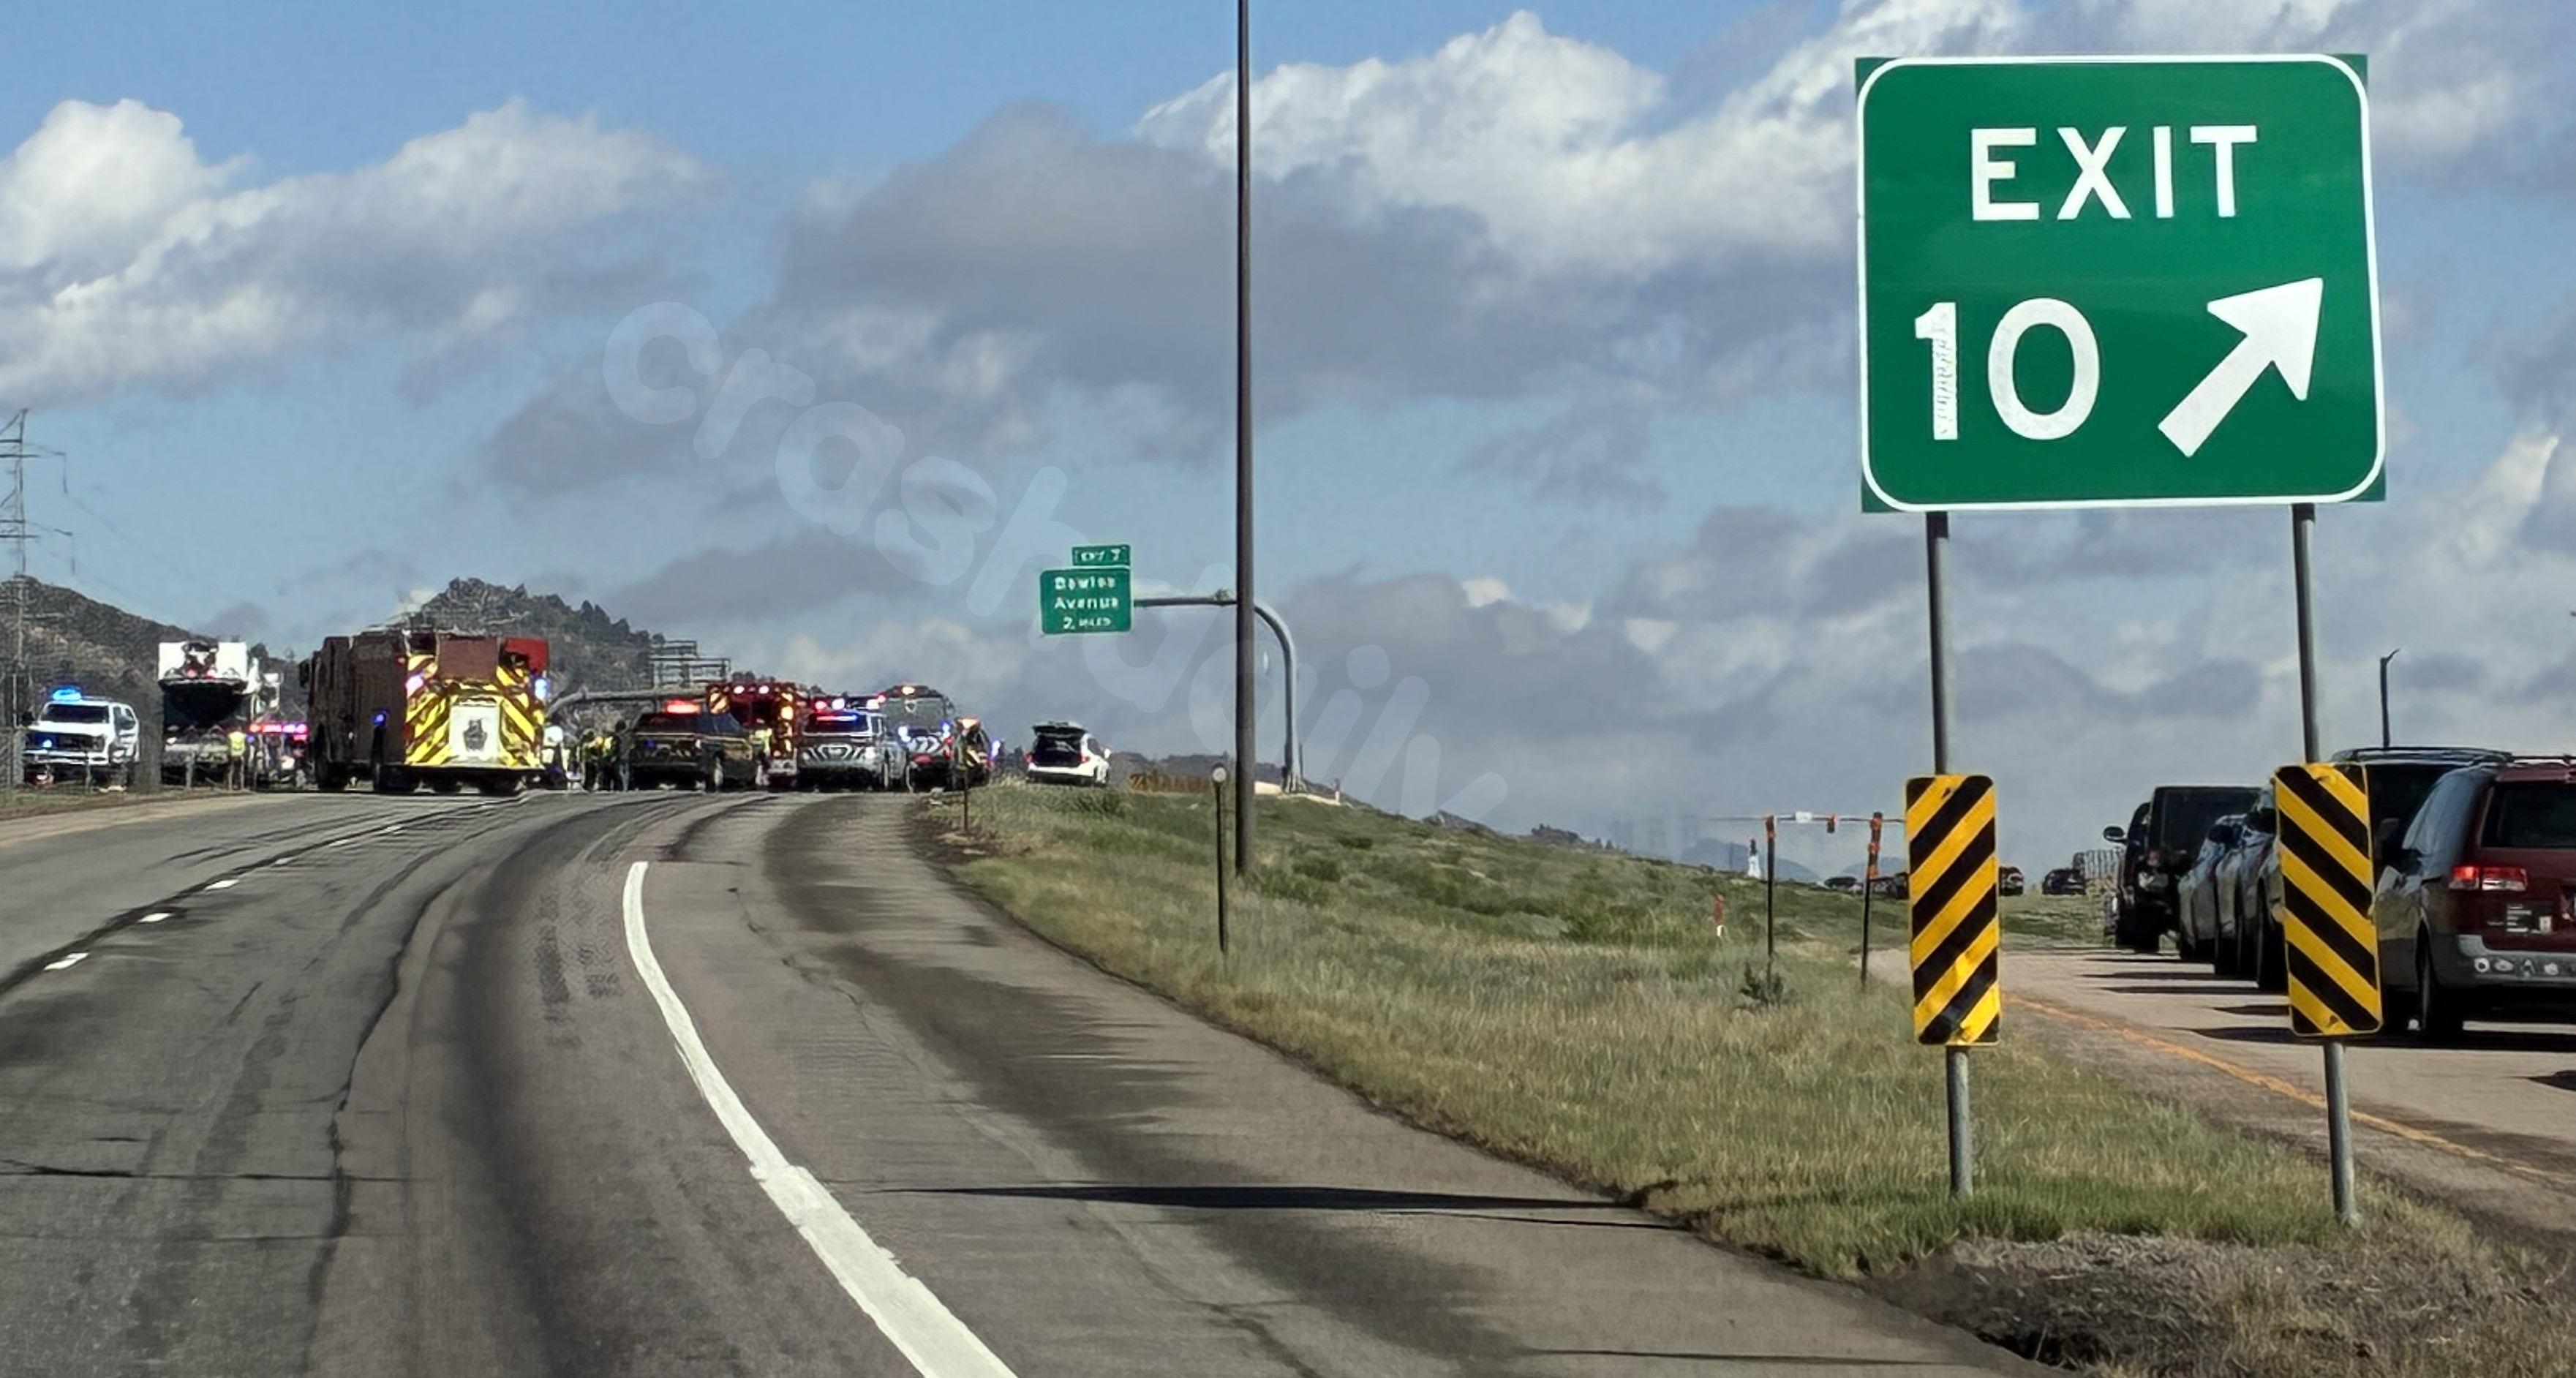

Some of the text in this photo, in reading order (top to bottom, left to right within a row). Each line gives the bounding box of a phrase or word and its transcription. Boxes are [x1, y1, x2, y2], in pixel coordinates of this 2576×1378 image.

[1970, 124, 2258, 221] EXIT
[1914, 298, 2101, 441] 10
[1062, 616, 1076, 630] 2
